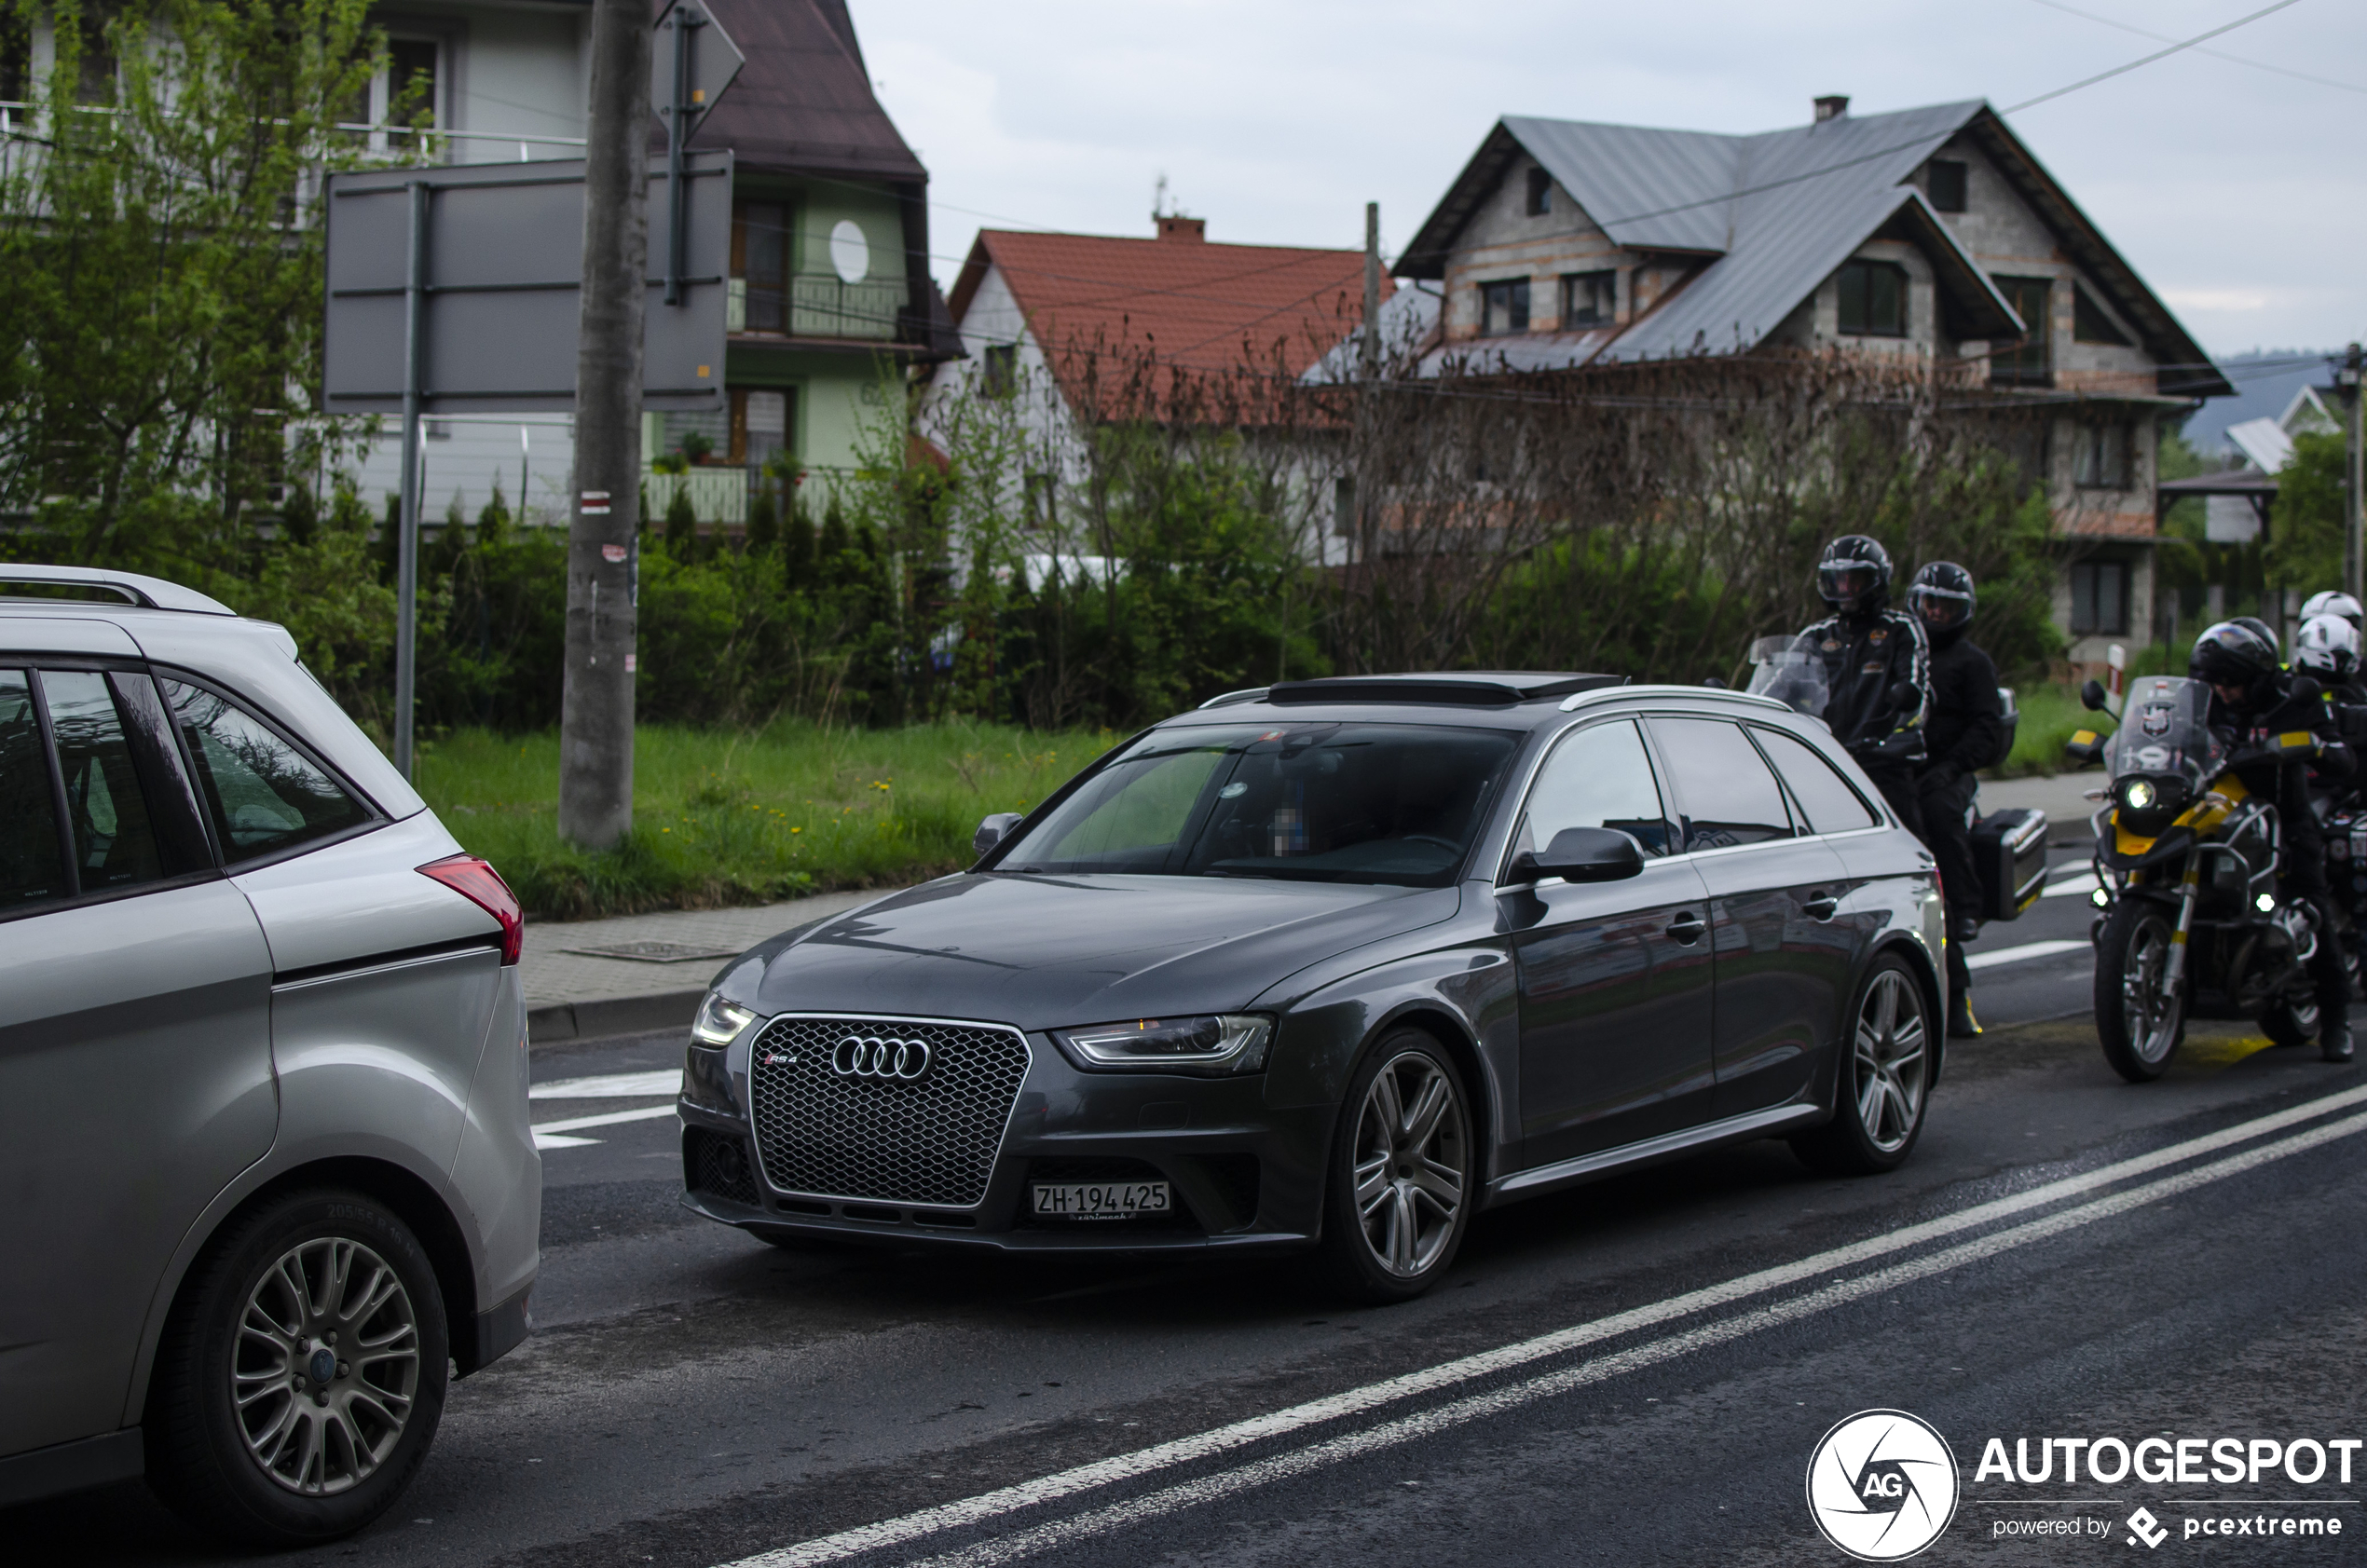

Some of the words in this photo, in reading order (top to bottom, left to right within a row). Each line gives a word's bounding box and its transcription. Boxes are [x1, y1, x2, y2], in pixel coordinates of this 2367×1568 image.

[1123, 1184, 1167, 1210] 425
[326, 1203, 375, 1224] 205/55
[376, 1216, 387, 1232] R
[389, 1226, 403, 1246] 16
